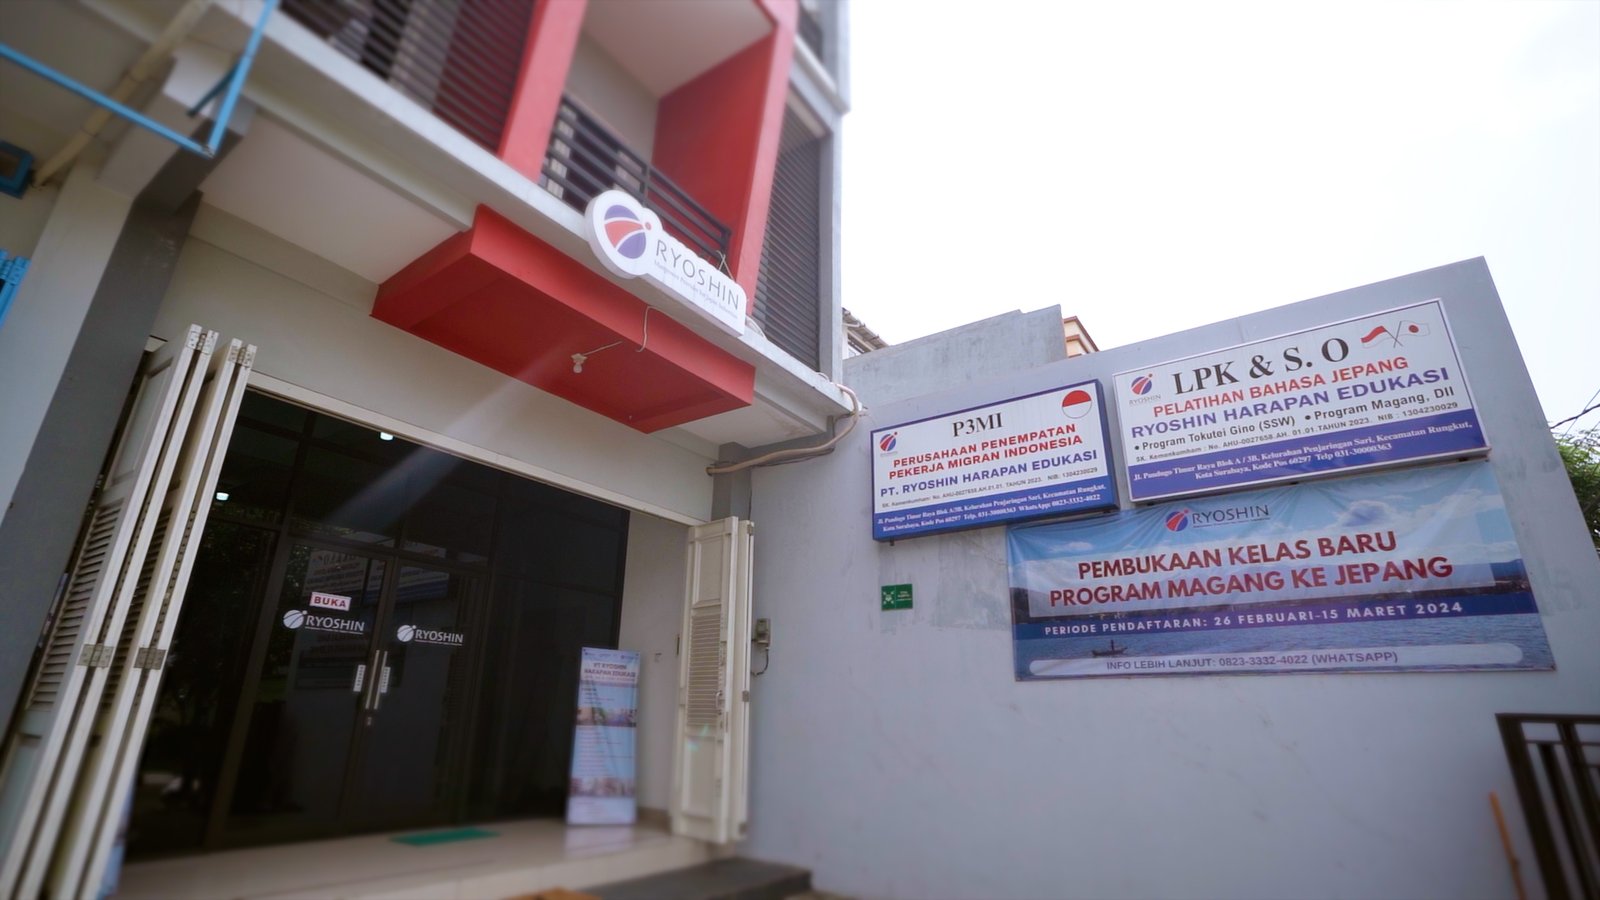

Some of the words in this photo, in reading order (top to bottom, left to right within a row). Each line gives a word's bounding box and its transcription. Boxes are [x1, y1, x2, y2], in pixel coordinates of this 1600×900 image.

[656, 239, 739, 310] RYOSHIN
[1173, 361, 1239, 395] LPK
[1249, 354, 1274, 379] &
[1283, 346, 1312, 372] S.
[1321, 338, 1349, 362] O
[1131, 412, 1217, 438] RYOSHIN
[1224, 390, 1330, 421] HARAPAN
[1336, 367, 1450, 400] EDUKASI
[1153, 390, 1244, 418] PELATIHAN
[1250, 373, 1326, 398] BAHASA
[1331, 356, 1408, 383] JEPANG
[952, 412, 1003, 437] P3MI
[1142, 437, 1186, 451] Program
[1189, 429, 1227, 443] Tokutei
[1230, 424, 1256, 436] Gino
[1259, 415, 1295, 432] (SSW)
[1314, 403, 1368, 421] Program
[1378, 413, 1394, 422] NIB
[1402, 402, 1458, 418] 1304230029
[893, 444, 977, 468] PERUSAHAAN
[982, 424, 1076, 450] PENEMPATAN
[1376, 428, 1426, 442] Kecamatan
[880, 487, 899, 497] PT.
[902, 476, 958, 494] RYOSHIN
[963, 463, 1027, 483] HARAPAN
[1032, 449, 1097, 470] EDUKASI
[889, 464, 944, 479] PEKERJA
[948, 451, 1000, 469] MIGRAN
[1004, 435, 1082, 458] INDONESIA
[1195, 470, 1213, 480] Kota
[1252, 461, 1273, 471] Kode
[1192, 505, 1270, 524] RYOSHIN
[1078, 548, 1222, 580] PEMBUKAAN
[1228, 539, 1311, 566] KELAS
[1317, 531, 1397, 557] BARU
[1050, 581, 1162, 607] PROGRAM
[1168, 570, 1285, 598] MAGANG
[1291, 567, 1327, 588] KE
[1335, 556, 1453, 585] JEPANG
[313, 596, 347, 608] BUKA
[1045, 624, 1097, 635] PERIODE
[1102, 618, 1208, 632] PENDAFTARAN:
[1214, 615, 1231, 626] 26
[1346, 605, 1407, 618] MARET
[1415, 601, 1463, 615] 2024
[305, 615, 365, 632] RYOSHIN
[415, 629, 464, 643] RYOSHIN
[1106, 661, 1131, 670] INFO
[1134, 660, 1166, 669] LEBIH
[1168, 658, 1217, 668] LANJUT:
[1218, 655, 1308, 667] 0823-3332-4022
[1311, 651, 1398, 667] (WHATSAPP)
